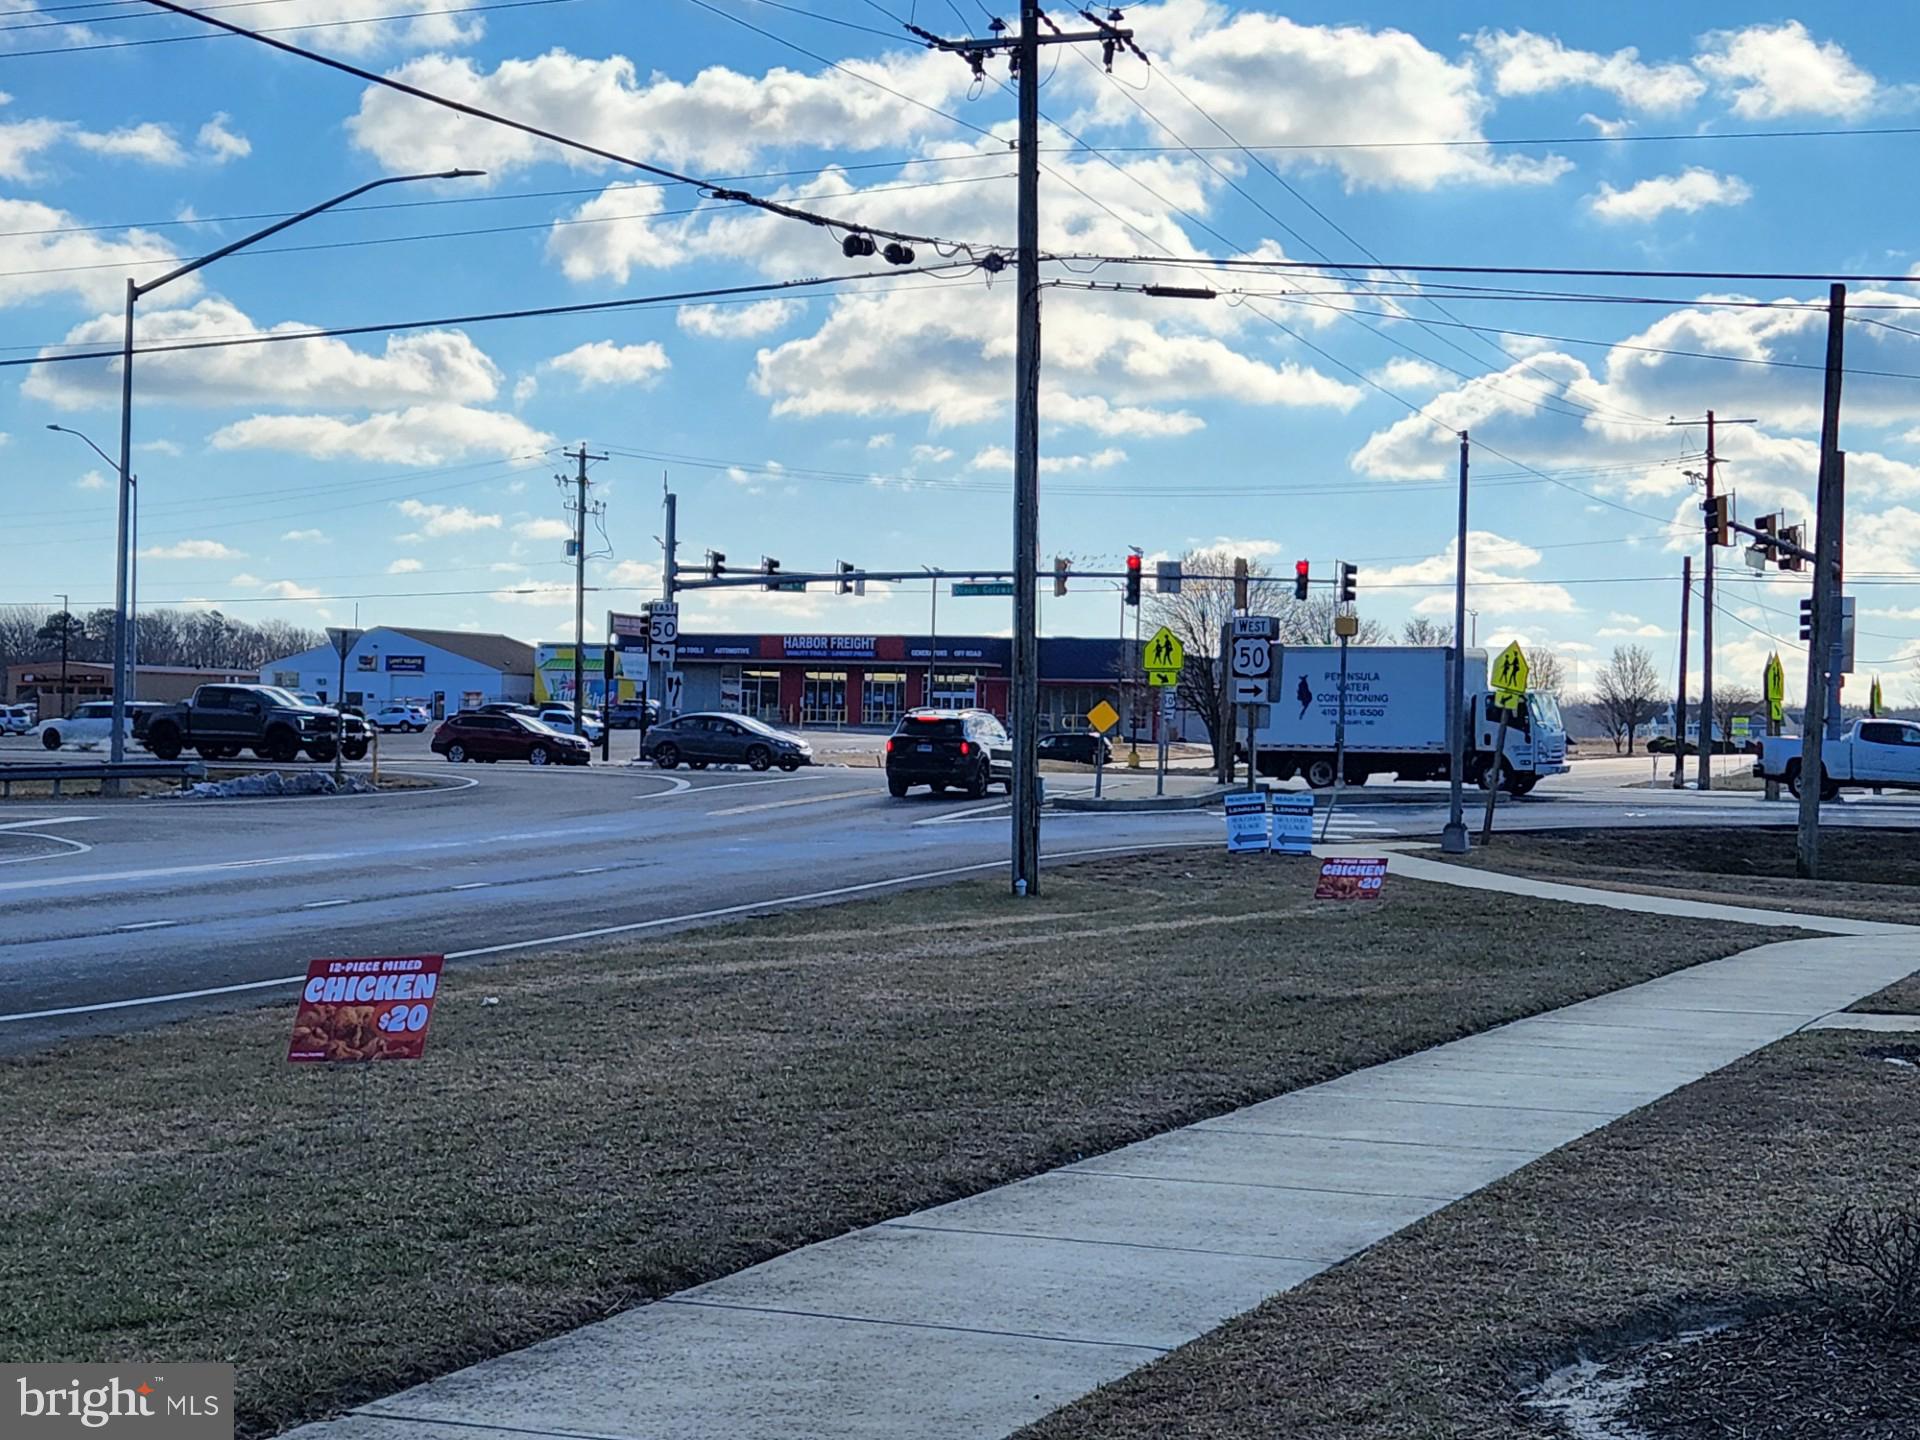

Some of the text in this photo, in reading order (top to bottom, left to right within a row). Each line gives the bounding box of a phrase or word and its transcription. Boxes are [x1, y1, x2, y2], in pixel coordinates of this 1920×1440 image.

[954, 585, 978, 594] Ocean
[654, 602, 675, 612] EAST
[652, 621, 676, 637] 50
[1238, 619, 1266, 632] WEST
[783, 636, 877, 650] HARBOR FREIGHT
[714, 647, 750, 655] AUTOMOTIVE
[1239, 647, 1264, 668] 50
[1324, 672, 1380, 681] PENNSULA
[1316, 693, 1389, 703] CONITIONING
[1321, 863, 1386, 876] CHICKEN
[329, 960, 423, 973] 12-PIECE MIXED
[304, 973, 438, 1003] CHICKEN
[378, 1004, 429, 1032] $20
